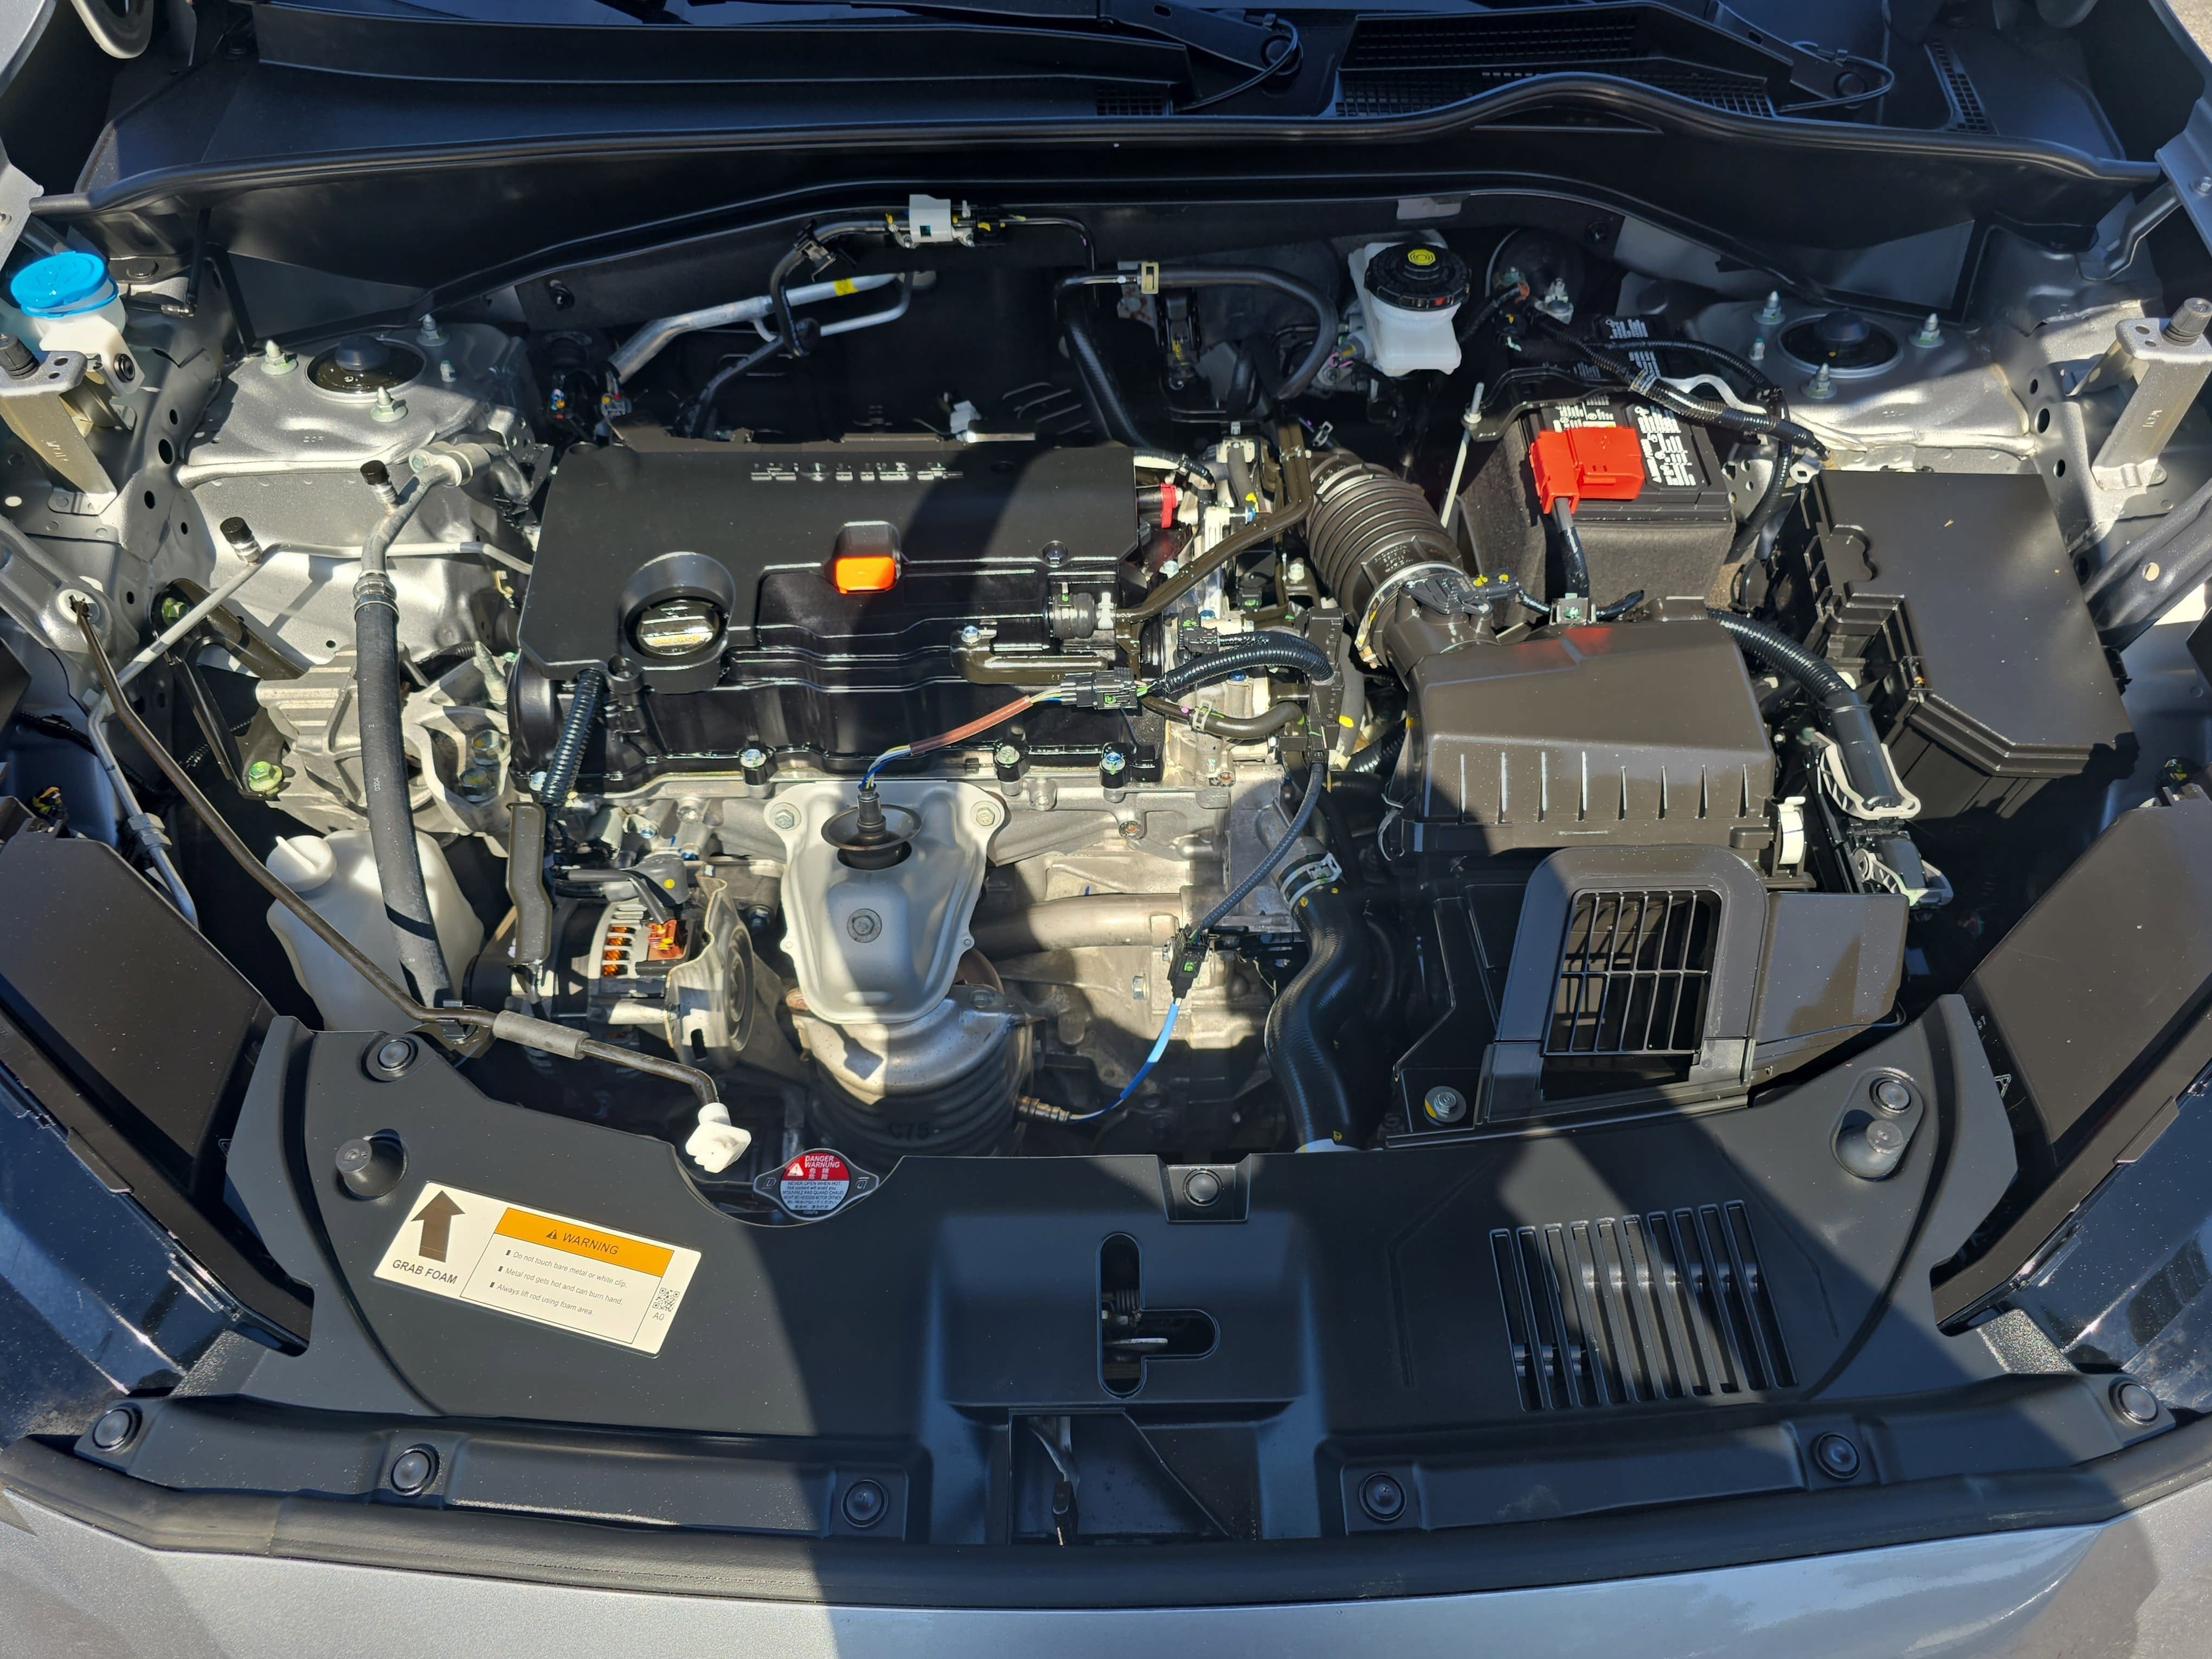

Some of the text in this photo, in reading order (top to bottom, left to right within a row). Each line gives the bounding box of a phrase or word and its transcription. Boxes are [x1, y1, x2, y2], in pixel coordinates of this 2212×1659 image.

[563, 1233, 619, 1255] WARNING
[393, 1259, 458, 1284] GRAB FOAM
[505, 1268, 524, 1277] Metal
[535, 1277, 550, 1285] gets
[550, 1280, 562, 1288] hot
[589, 1290, 604, 1300] burn
[605, 1295, 622, 1305] hand.
[535, 1257, 552, 1267] touch
[554, 1262, 568, 1271] bare
[569, 1268, 588, 1276] metal
[596, 1275, 613, 1283] white
[614, 1279, 627, 1288] clip.
[497, 1284, 519, 1295] Always
[542, 1297, 559, 1307] using
[560, 1301, 577, 1310] foam
[577, 1307, 594, 1315] area.
